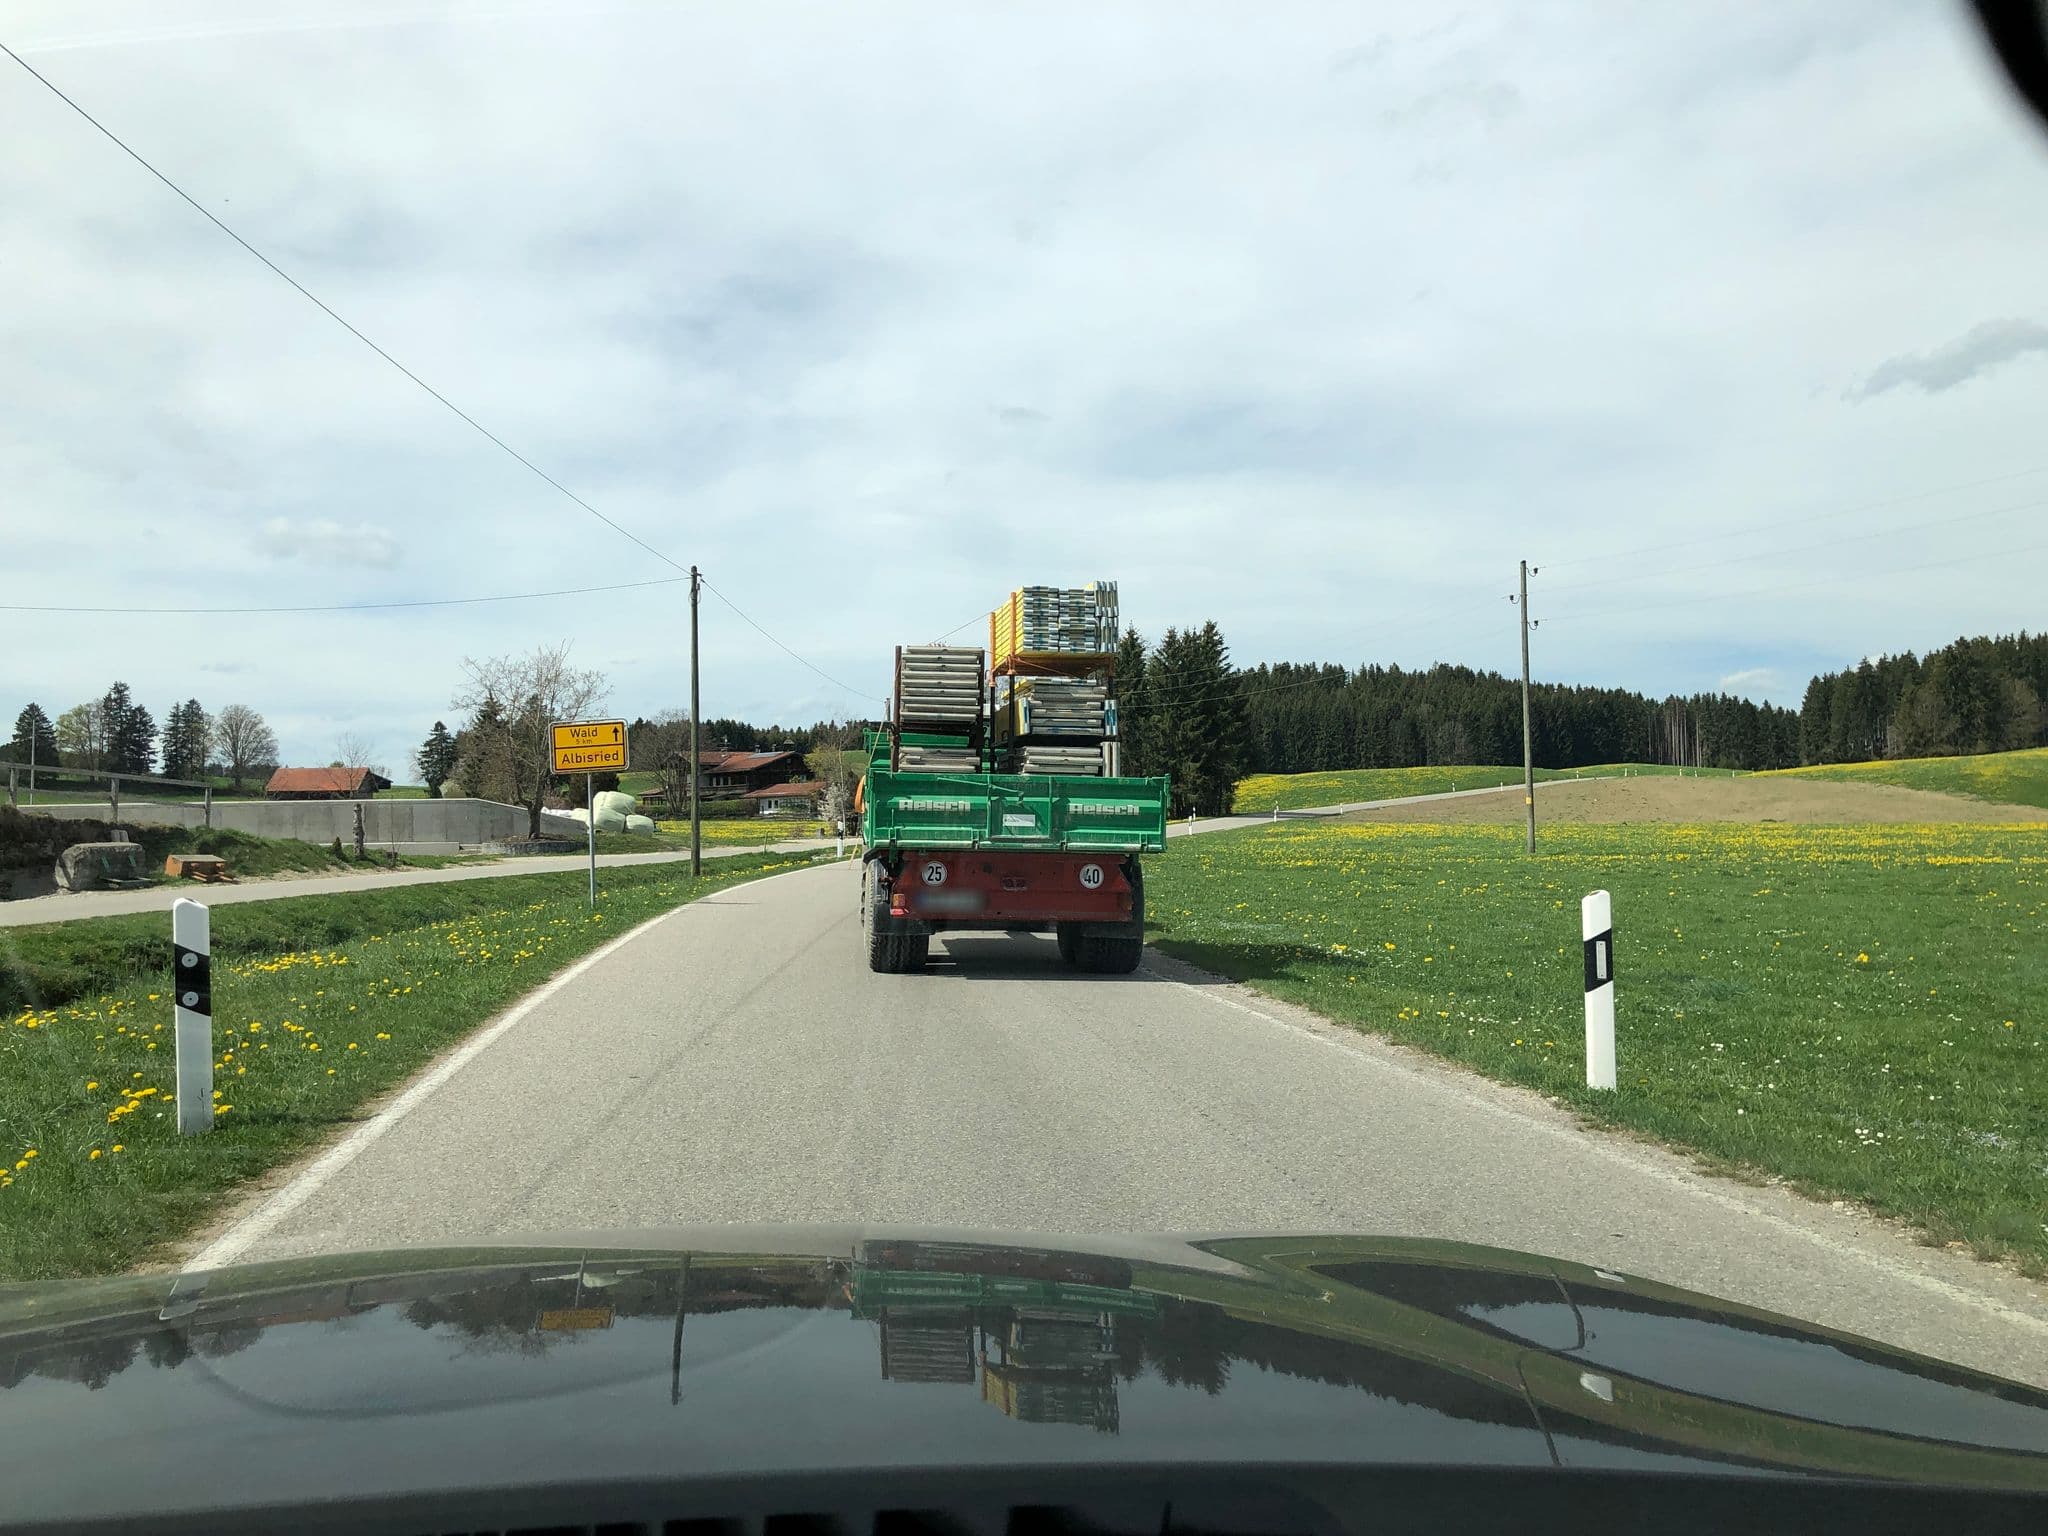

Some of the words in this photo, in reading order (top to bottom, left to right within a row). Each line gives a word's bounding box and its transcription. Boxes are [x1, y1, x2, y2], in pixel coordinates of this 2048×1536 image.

[570, 727, 598, 738] Wald
[562, 750, 619, 764] Albisried
[927, 866, 942, 881] 25
[1084, 868, 1100, 884] 40
